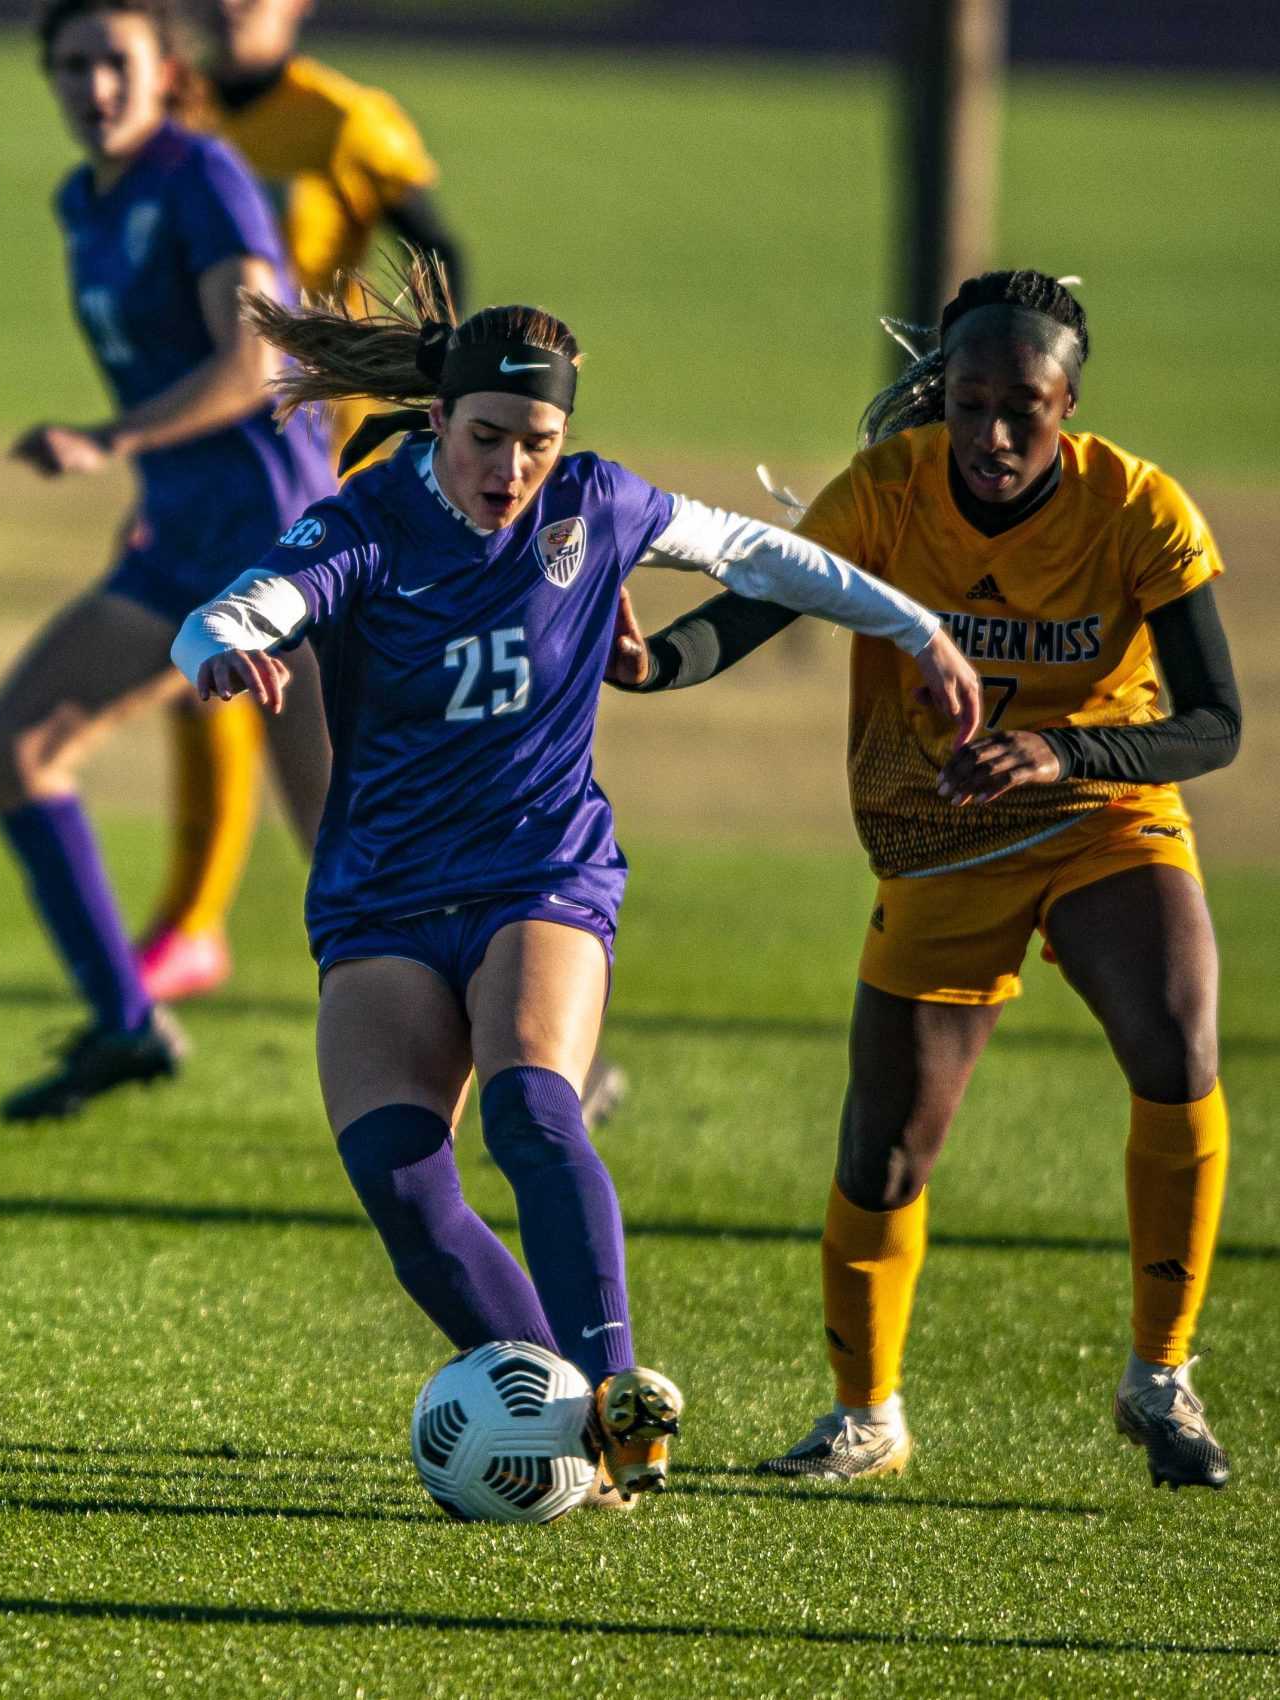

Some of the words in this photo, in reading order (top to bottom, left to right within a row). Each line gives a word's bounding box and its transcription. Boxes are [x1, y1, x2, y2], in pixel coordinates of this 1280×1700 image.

[279, 518, 322, 546] SEC
[545, 541, 579, 566] LSU
[1033, 613, 1102, 664] MISS
[443, 626, 530, 721] 25
